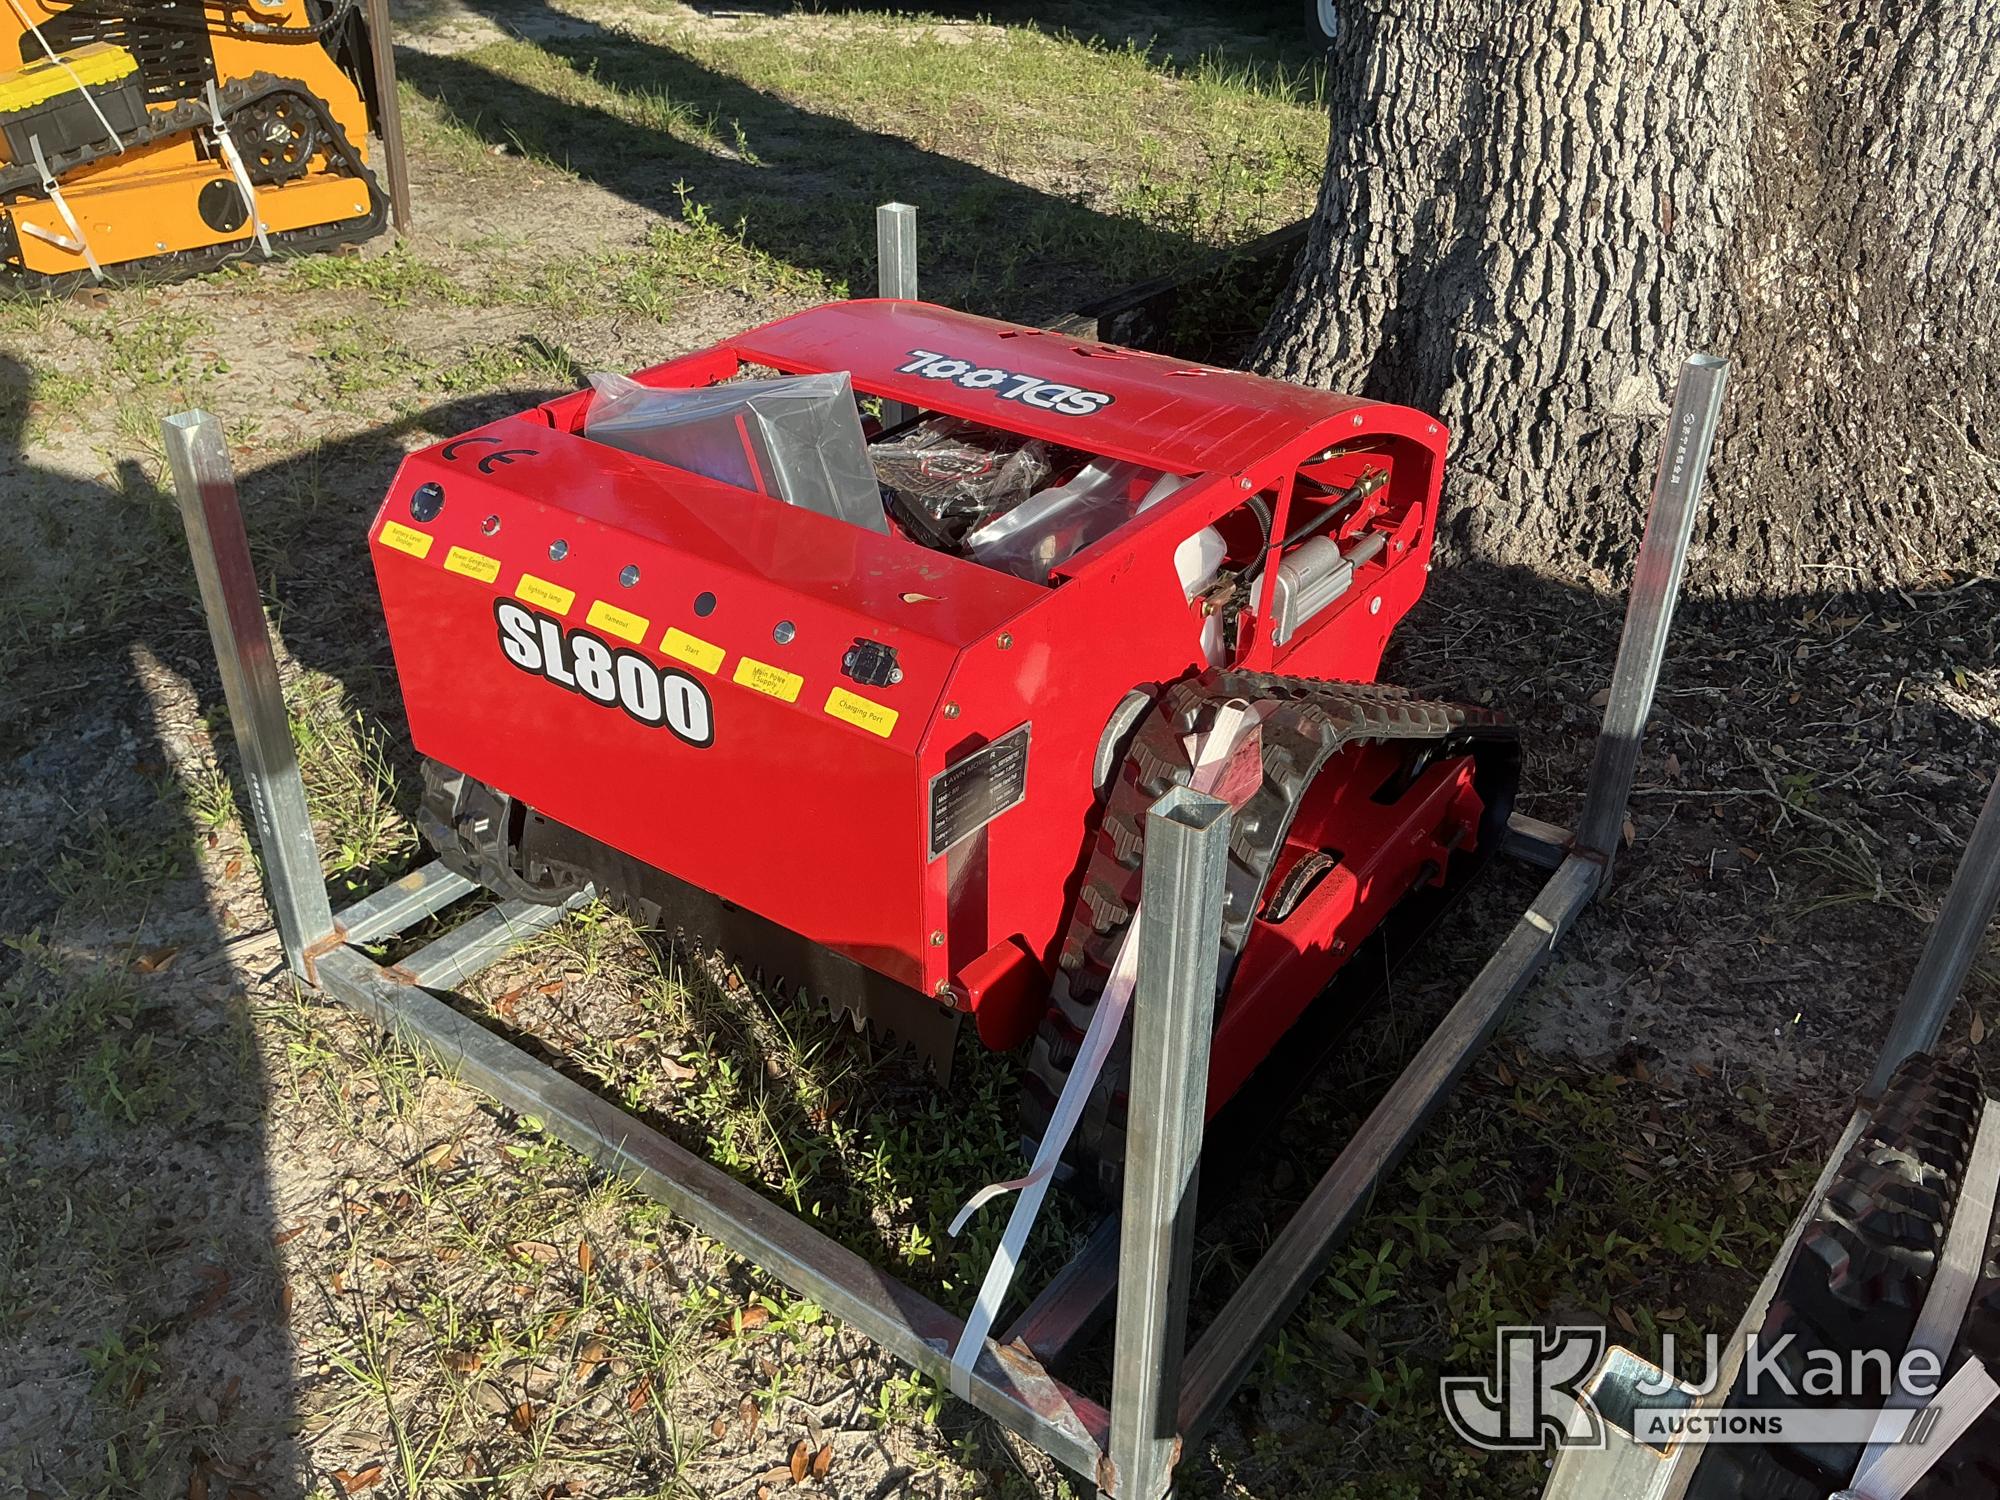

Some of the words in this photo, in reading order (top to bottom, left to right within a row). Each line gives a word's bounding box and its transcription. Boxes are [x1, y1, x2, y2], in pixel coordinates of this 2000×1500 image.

[442, 437, 539, 474] CE
[684, 644, 699, 656] Start
[496, 600, 712, 746] SL800
[753, 667, 769, 679] Main
[757, 675, 778, 690] Supply
[840, 699, 868, 718] Charging
[869, 711, 883, 724] Port
